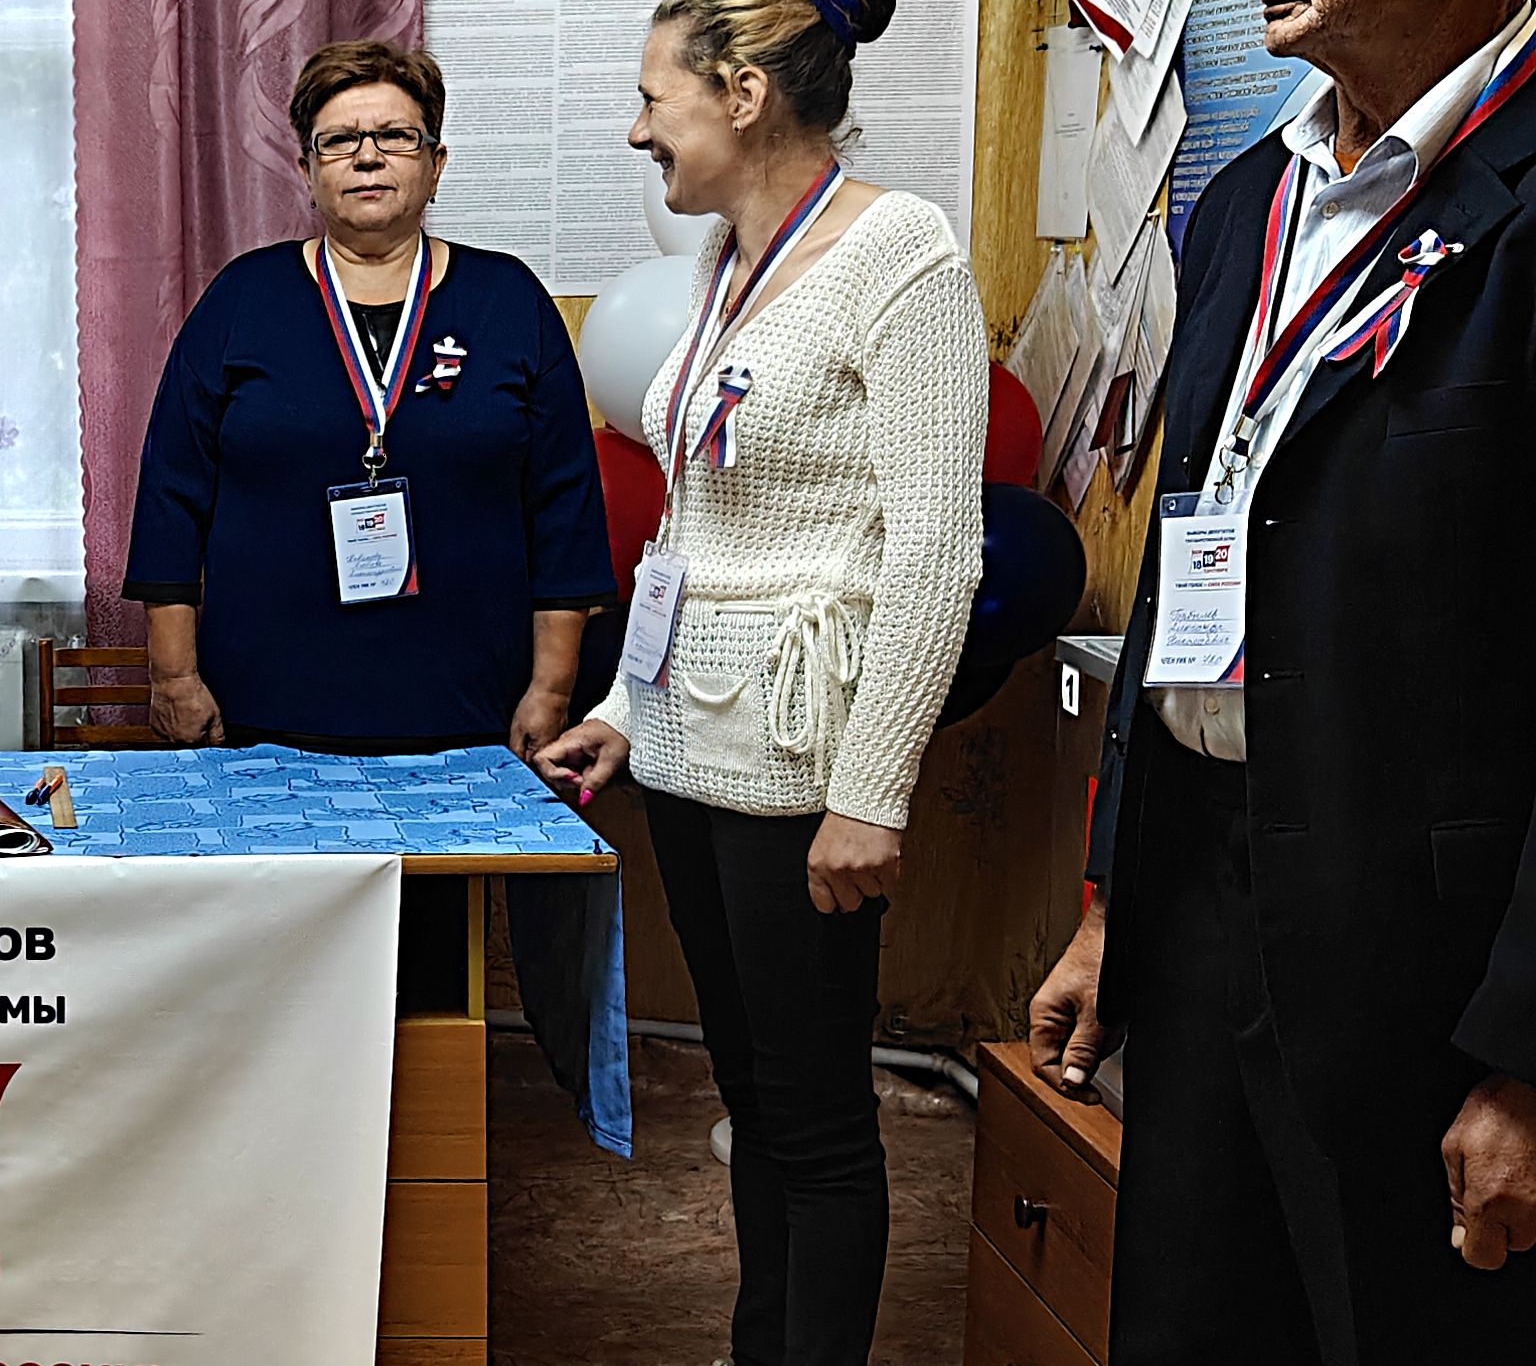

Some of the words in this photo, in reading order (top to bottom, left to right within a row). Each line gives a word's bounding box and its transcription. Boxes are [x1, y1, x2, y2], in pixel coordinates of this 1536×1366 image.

[1204, 554, 1214, 565] 19
[1215, 548, 1227, 560] 20
[1193, 560, 1202, 570] 18
